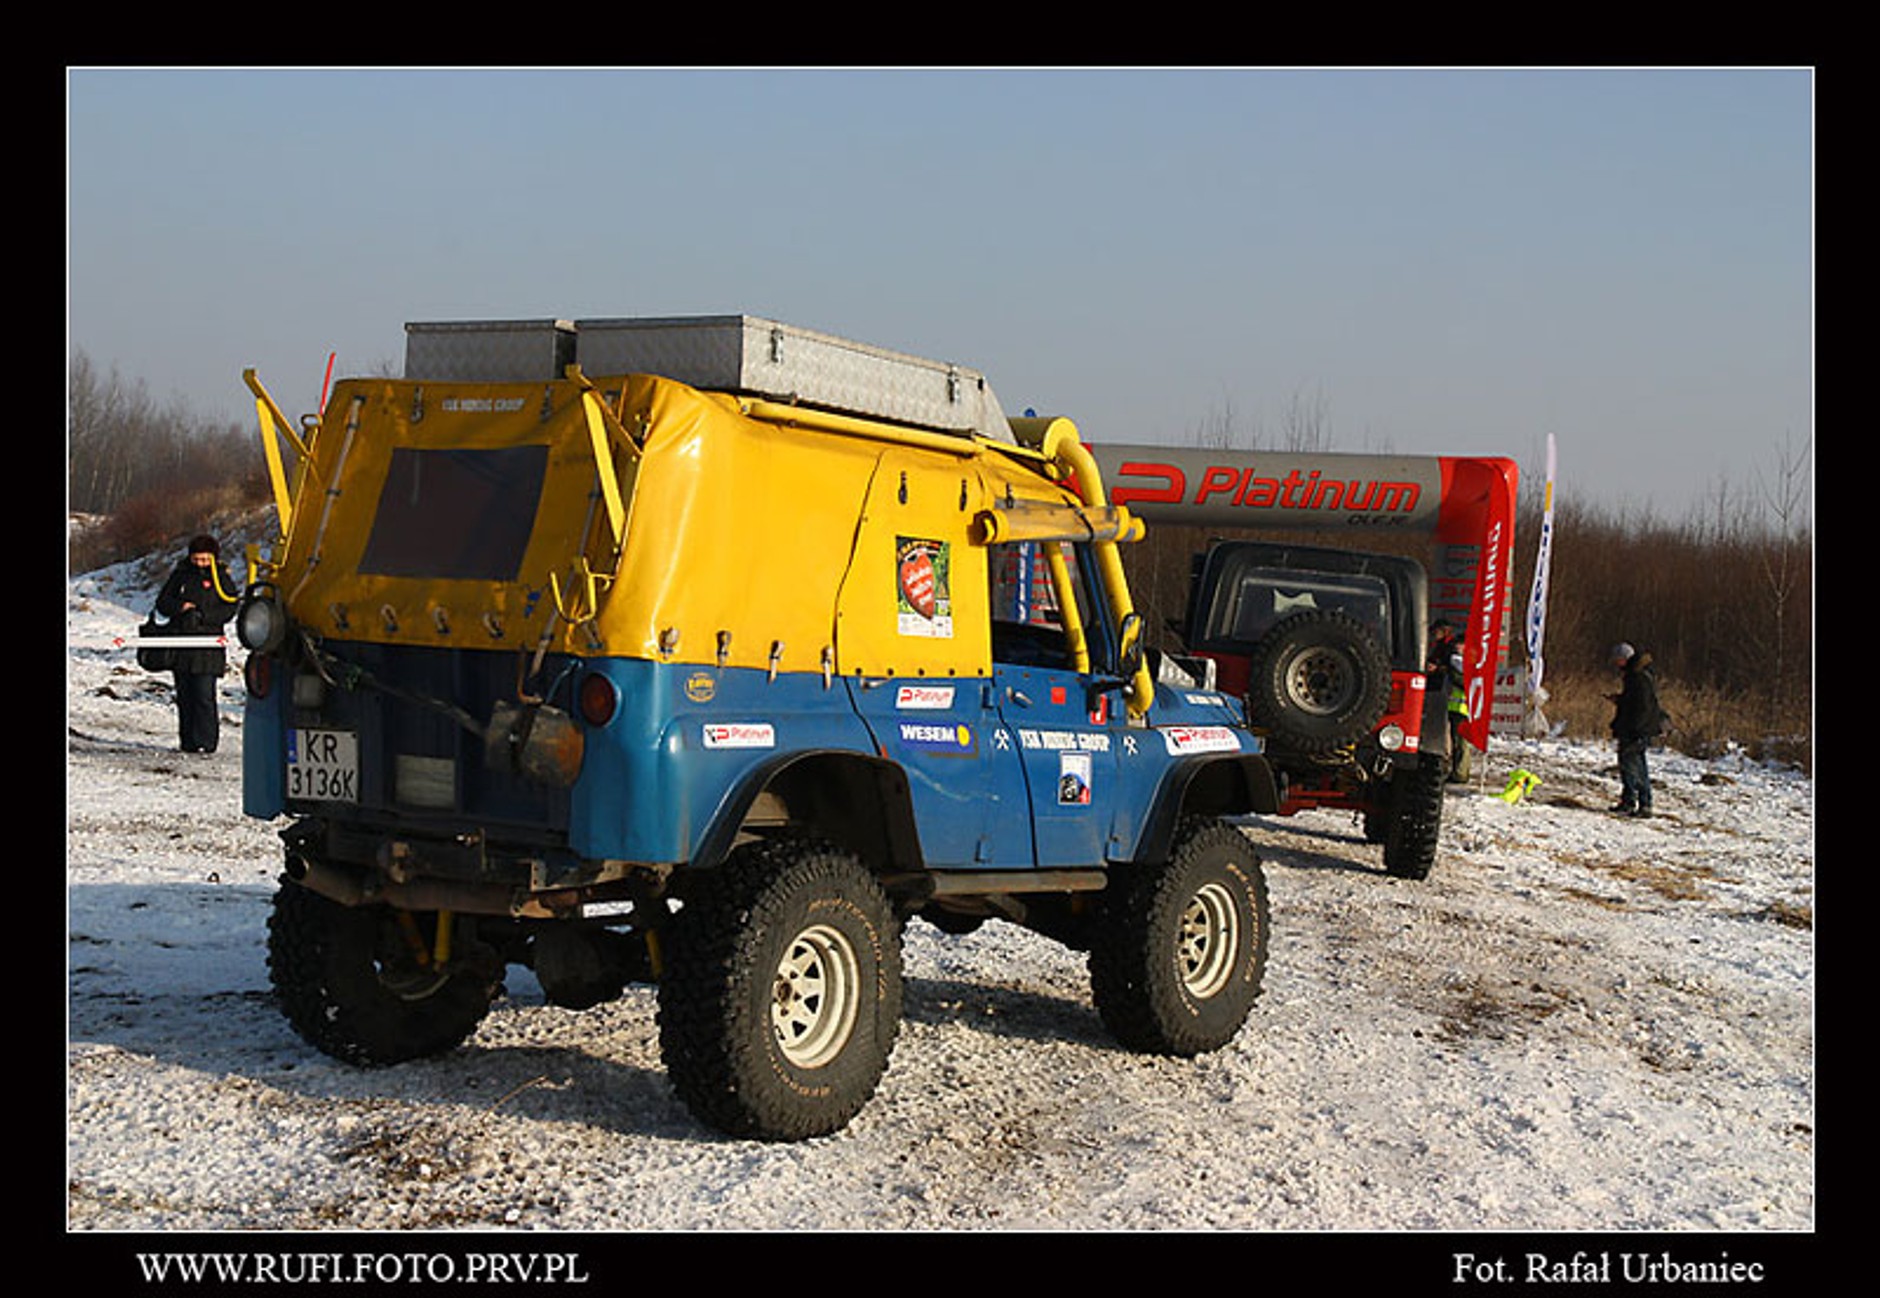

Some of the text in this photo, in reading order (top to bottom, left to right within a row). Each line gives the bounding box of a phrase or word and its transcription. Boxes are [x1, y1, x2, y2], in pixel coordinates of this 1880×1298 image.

[1194, 465, 1420, 512] Platinum
[305, 731, 338, 763] KR
[900, 724, 956, 742] WESEM
[290, 766, 354, 799] 3136K
